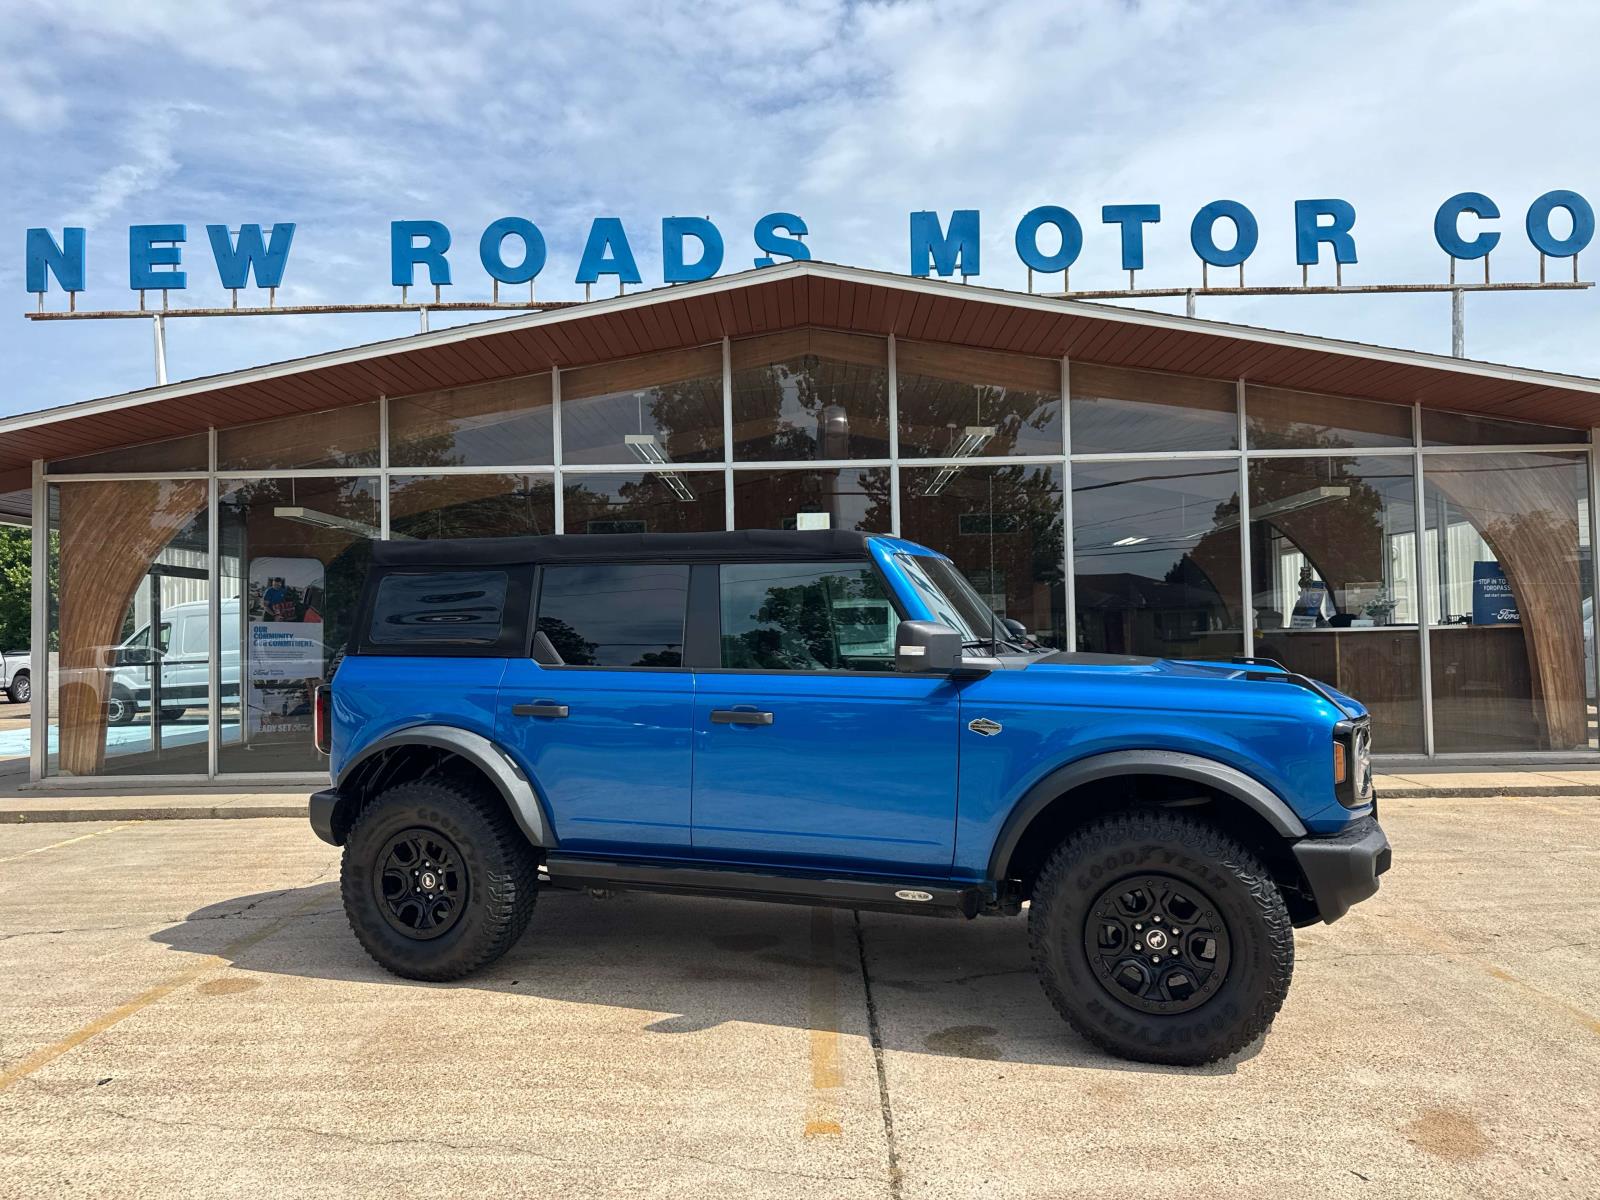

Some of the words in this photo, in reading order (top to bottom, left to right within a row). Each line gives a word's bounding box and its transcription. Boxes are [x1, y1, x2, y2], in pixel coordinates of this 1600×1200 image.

[26, 222, 296, 294] NEW
[391, 211, 812, 291] ROADS
[910, 198, 1359, 277] MOTOR
[1434, 189, 1595, 261] CO
[253, 625, 268, 633] OUR
[255, 724, 278, 732] EADY
[278, 724, 291, 732] SET
[1077, 847, 1229, 890] GOODYEAR
